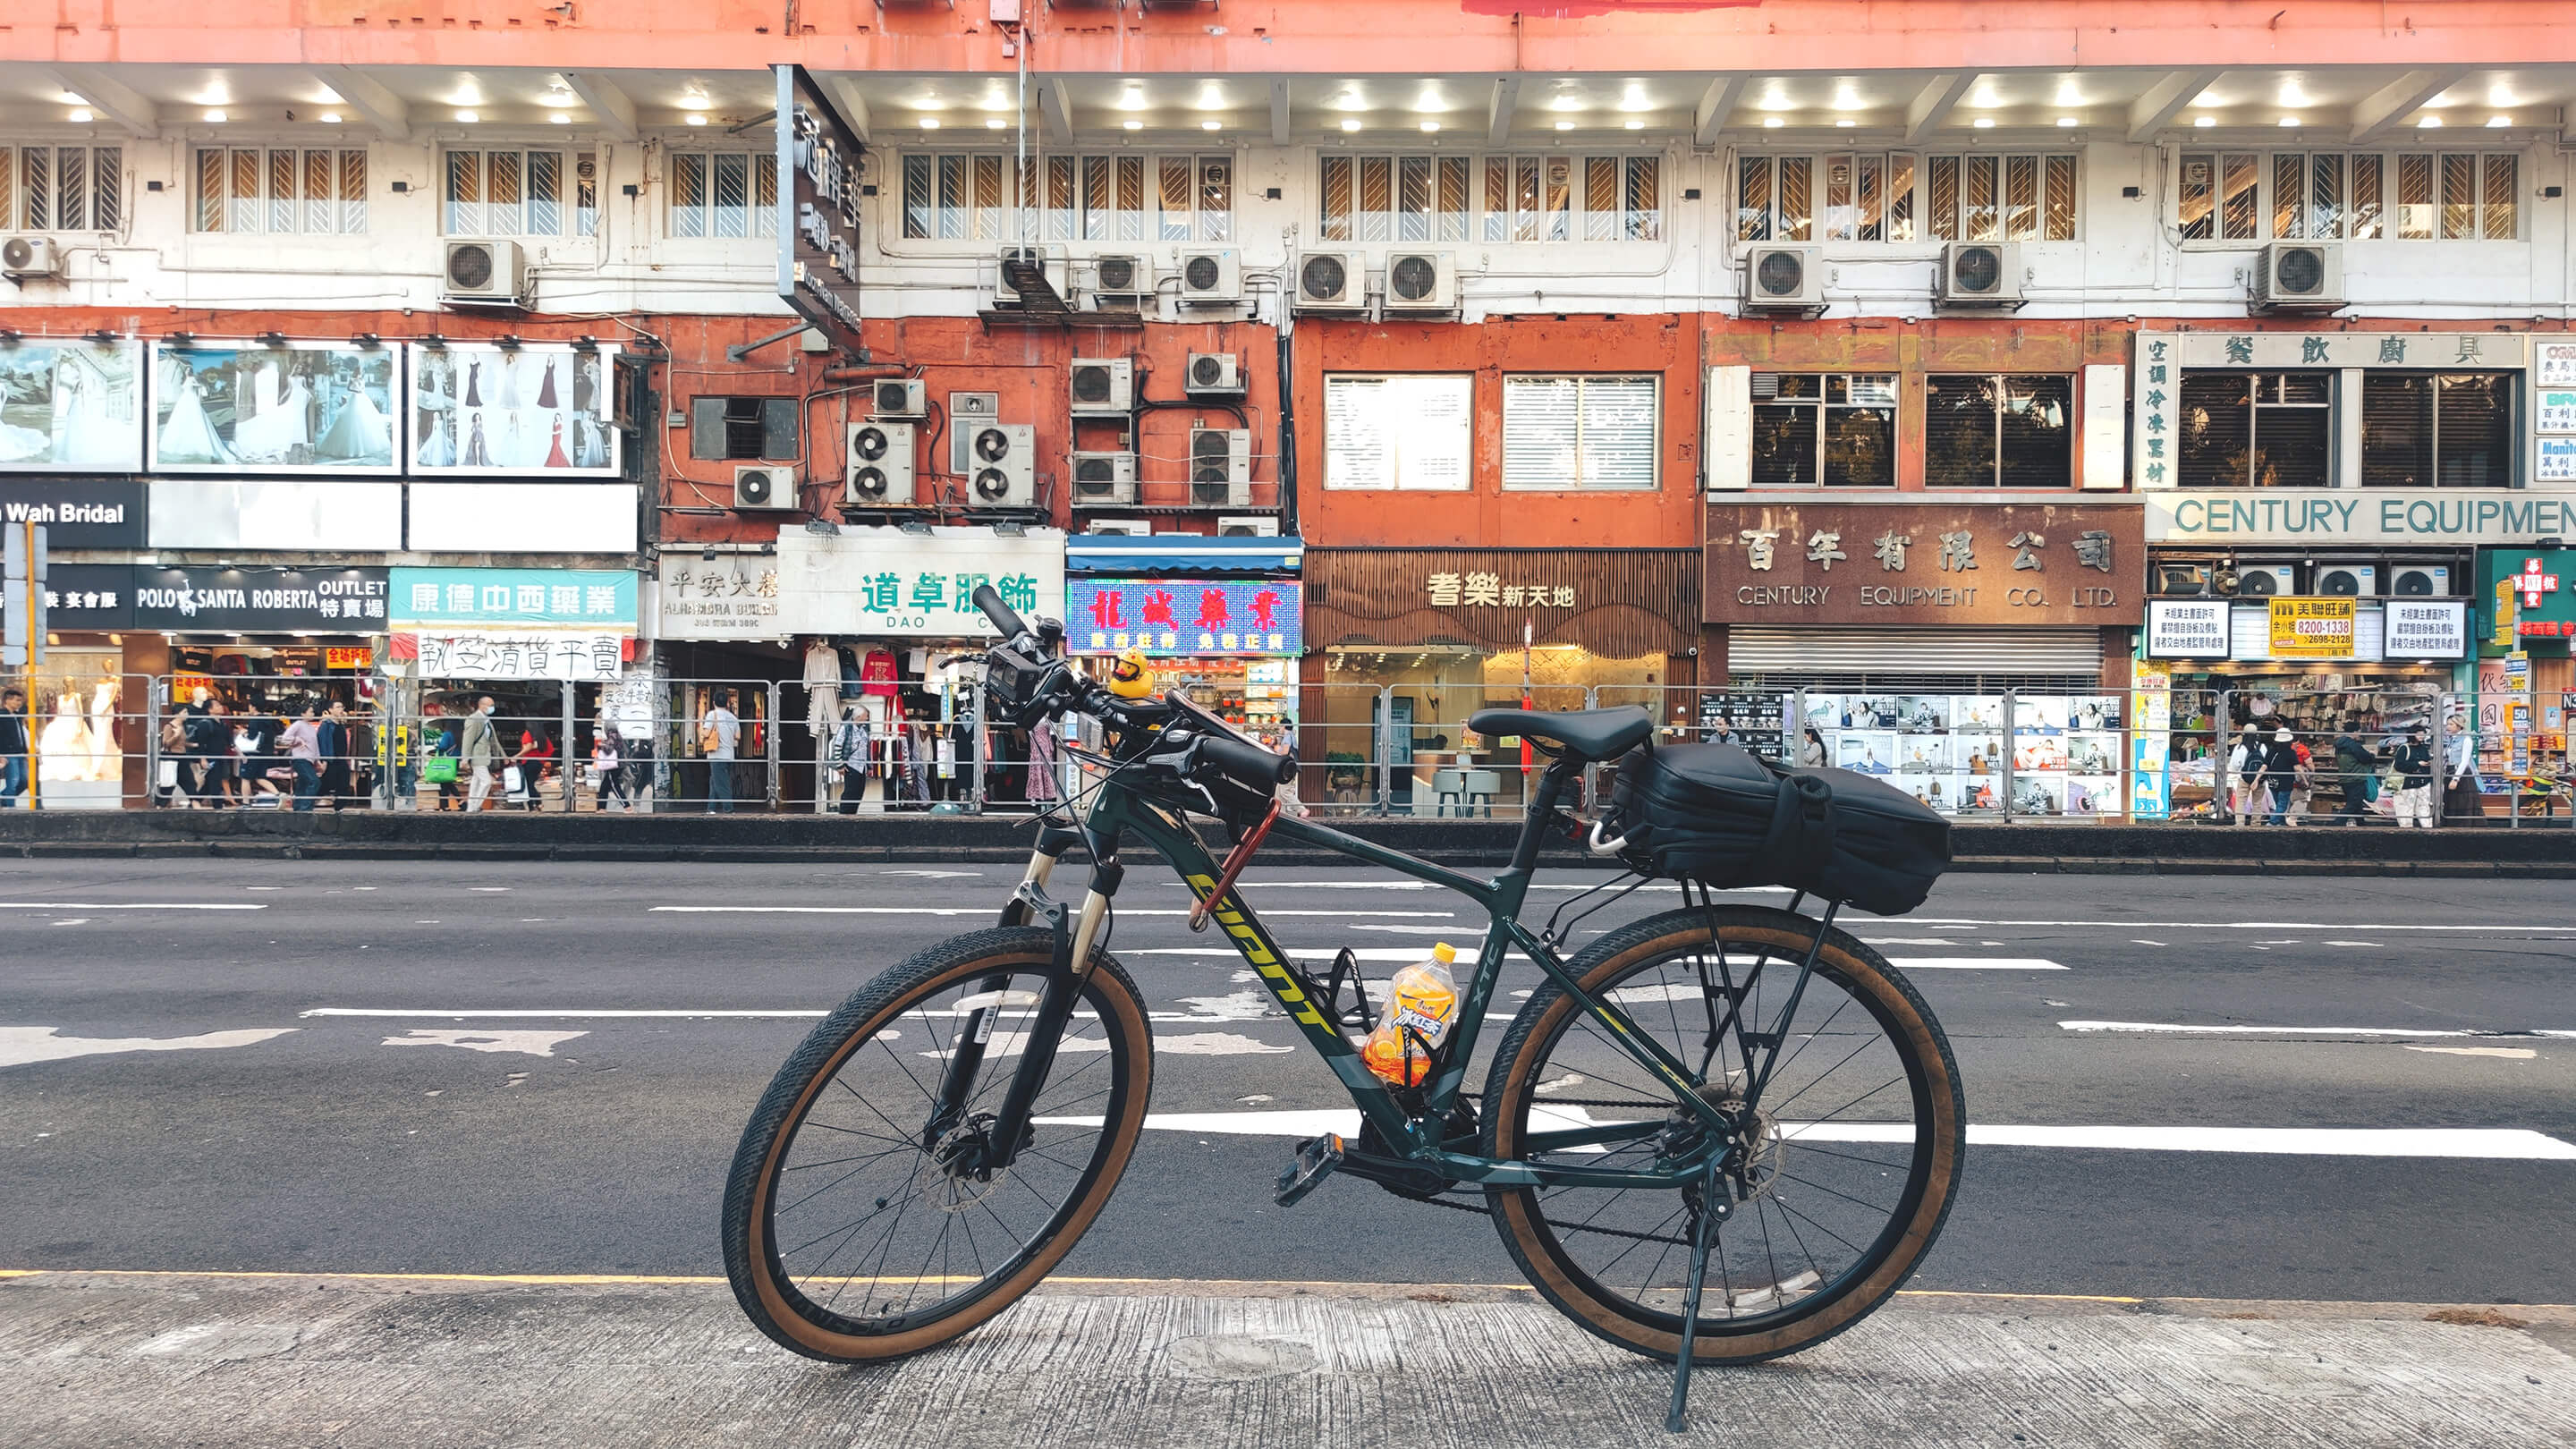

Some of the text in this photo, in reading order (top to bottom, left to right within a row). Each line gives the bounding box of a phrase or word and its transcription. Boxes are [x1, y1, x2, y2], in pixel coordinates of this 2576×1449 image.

[2224, 335, 2484, 365] 餐飲廚具
[2543, 409, 2576, 419] 百利
[6, 503, 55, 522] Wah
[60, 503, 124, 523] Bridal
[2174, 499, 2359, 533] CENTURY
[1740, 529, 2111, 572] 百年有限公司
[138, 588, 318, 609] POLO SANTA ROBERTA
[318, 580, 386, 596] OUTLET
[411, 583, 615, 614] 康德中西藥業
[861, 572, 1038, 614] 道草服飾
[1737, 586, 2117, 607] CENTURY EQUIPMENT CO. LTD.
[319, 598, 385, 618] 特賣場
[887, 617, 925, 628] DAO
[2298, 621, 2349, 633] 8200-1338
[2514, 709, 2527, 719] 50
[1185, 874, 1338, 1038] GIANT
[1473, 942, 1499, 1009] XTC
